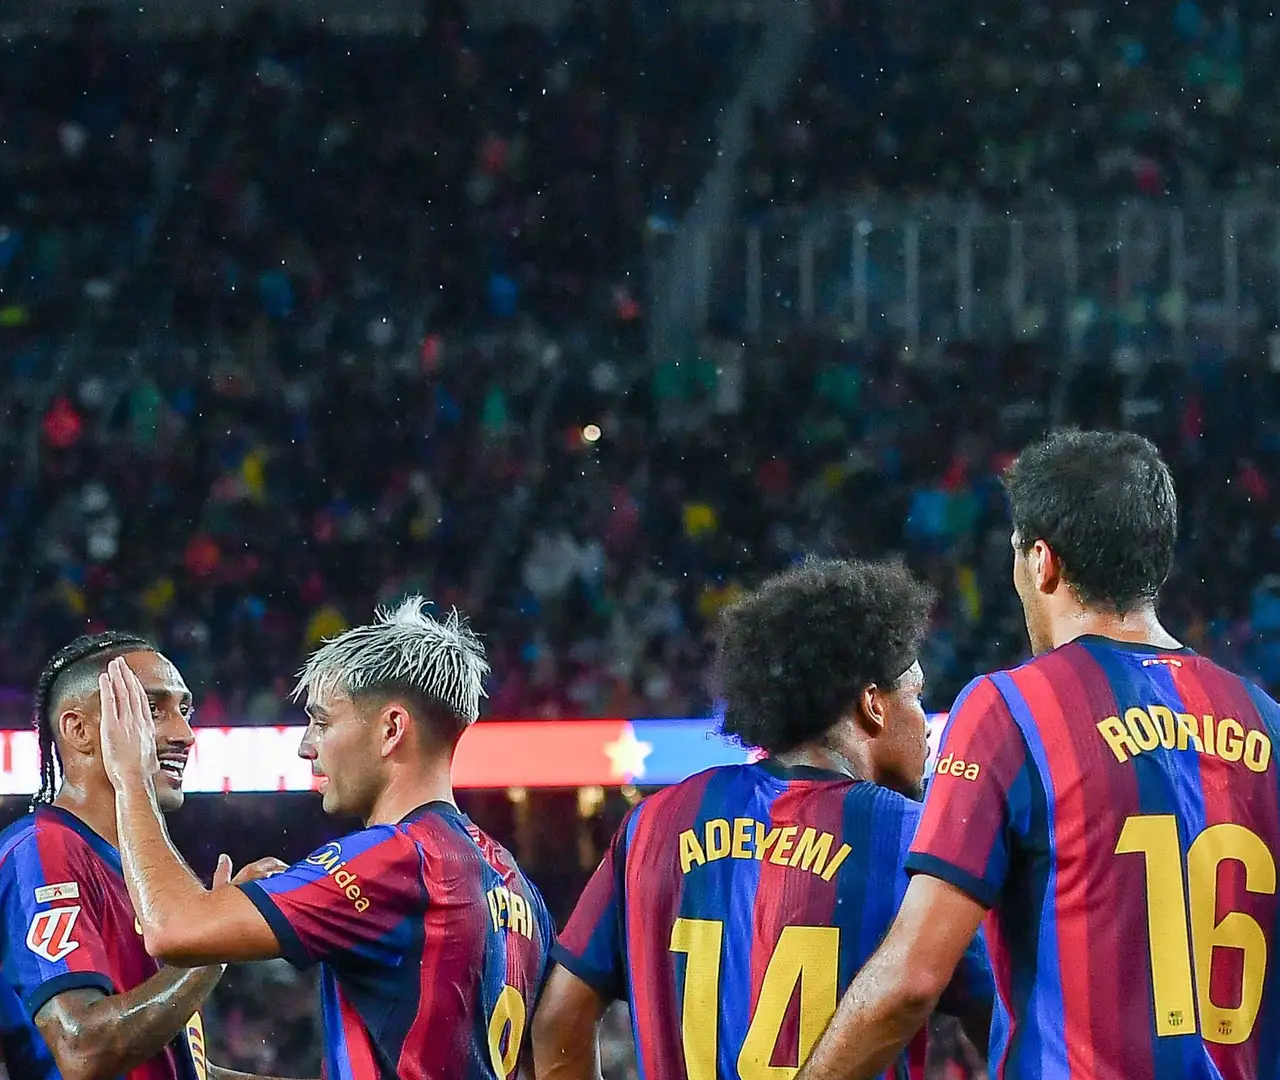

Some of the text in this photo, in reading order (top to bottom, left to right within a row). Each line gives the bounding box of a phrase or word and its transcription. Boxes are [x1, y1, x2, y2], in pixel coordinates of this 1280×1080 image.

[932, 752, 981, 781] idea
[1097, 705, 1272, 773] RODRIGO
[306, 842, 370, 913] Midea
[678, 817, 852, 882] ADEYEMI
[1115, 814, 1277, 1045] 16
